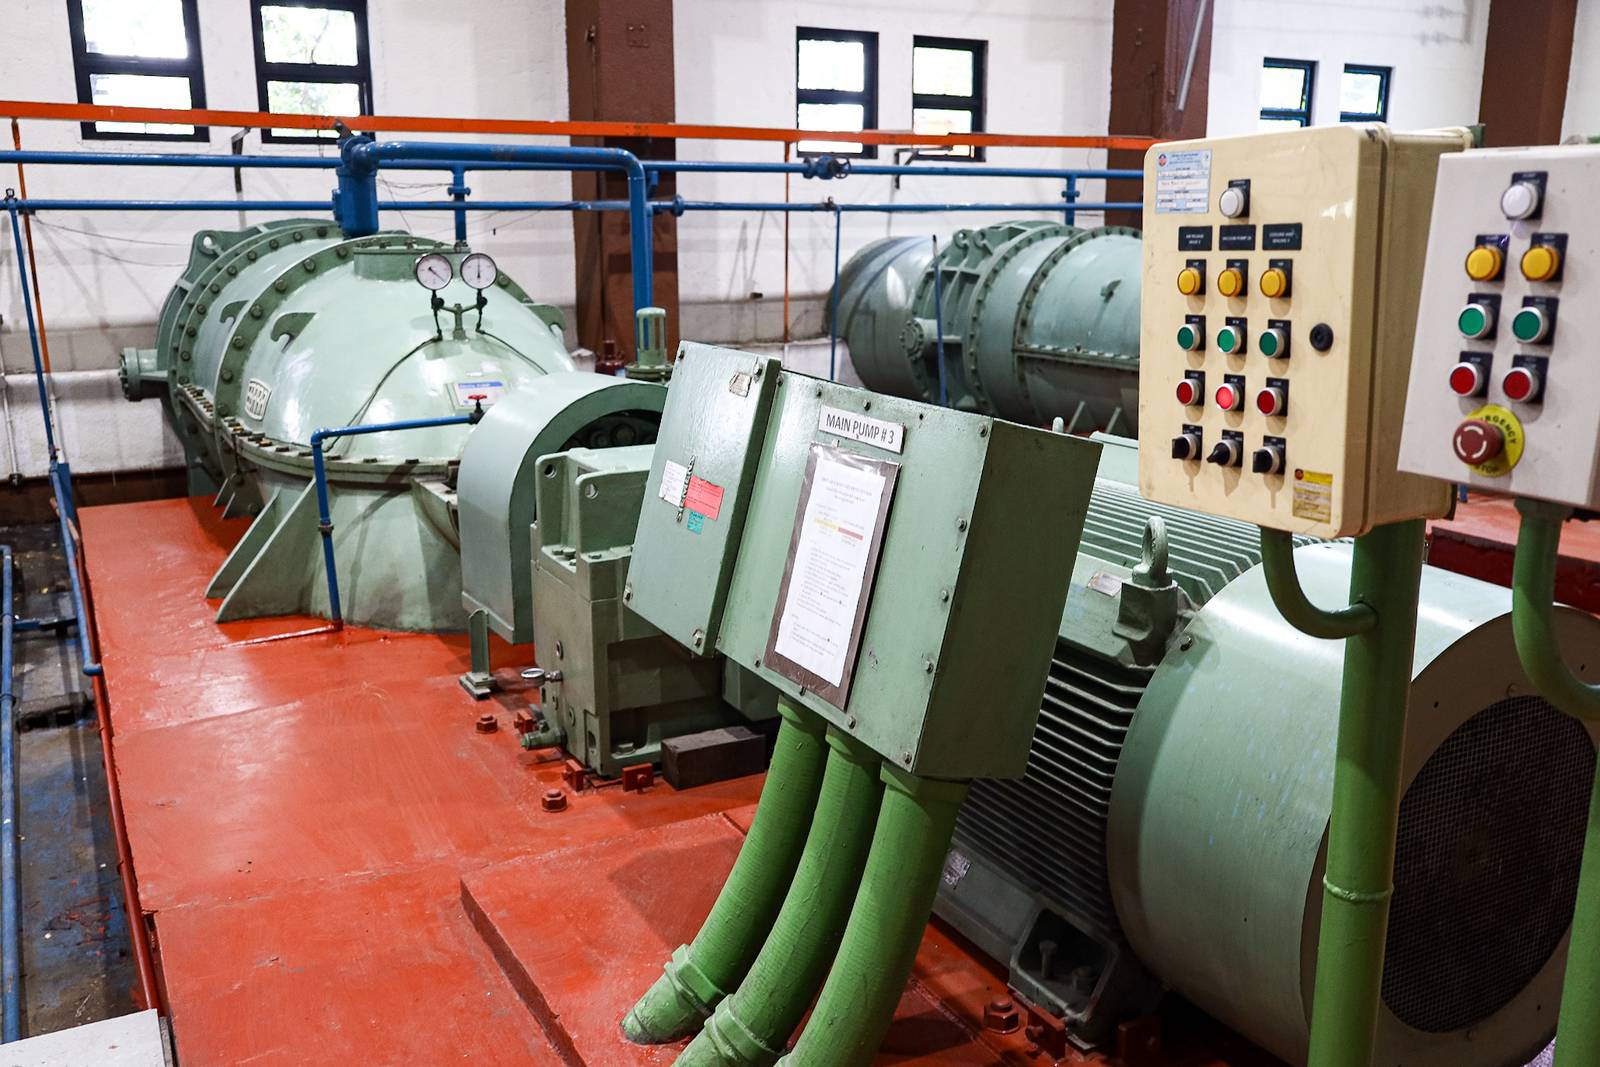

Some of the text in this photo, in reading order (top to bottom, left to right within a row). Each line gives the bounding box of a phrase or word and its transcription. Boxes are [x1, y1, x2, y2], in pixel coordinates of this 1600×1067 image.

[826, 414, 851, 432] MAIN
[853, 420, 880, 439] PUMP
[1481, 414, 1517, 444] RGENCY
